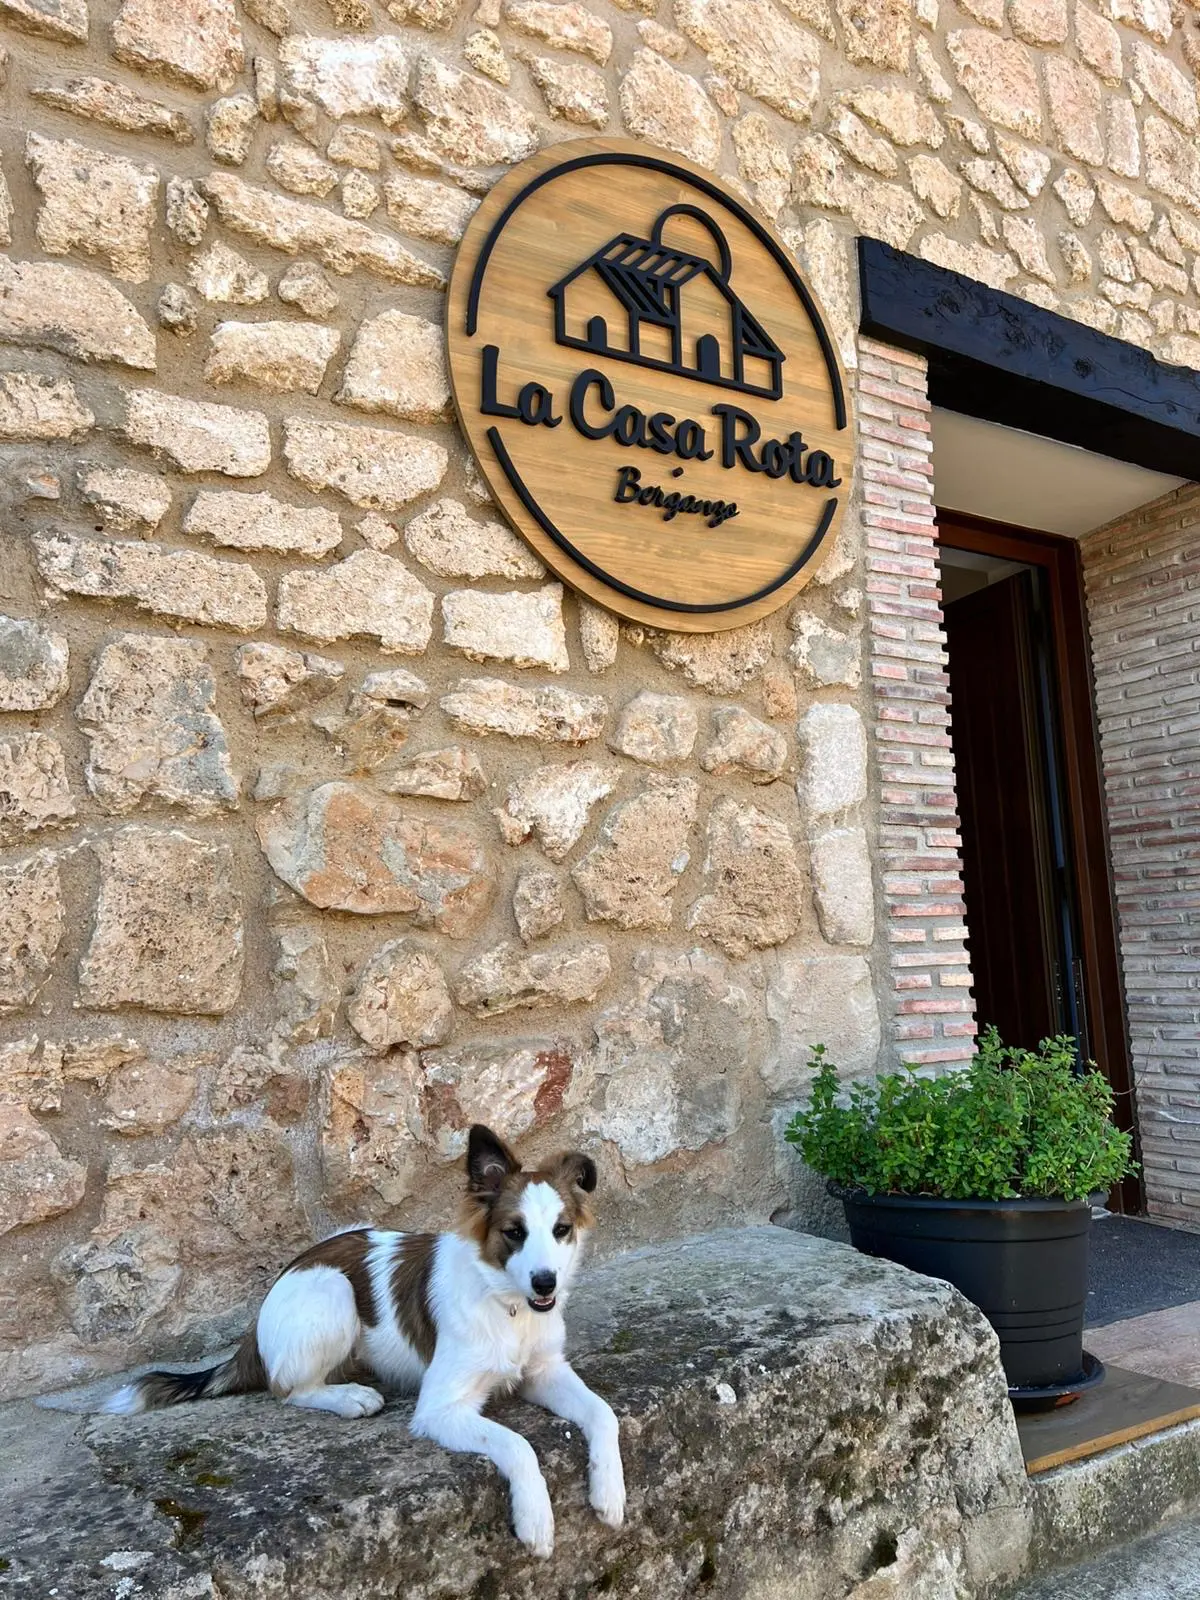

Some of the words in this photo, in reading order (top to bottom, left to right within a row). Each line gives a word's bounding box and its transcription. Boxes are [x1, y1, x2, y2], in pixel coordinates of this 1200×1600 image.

[481, 344, 562, 427] La
[570, 368, 714, 460] Casa
[712, 403, 842, 488] Rota
